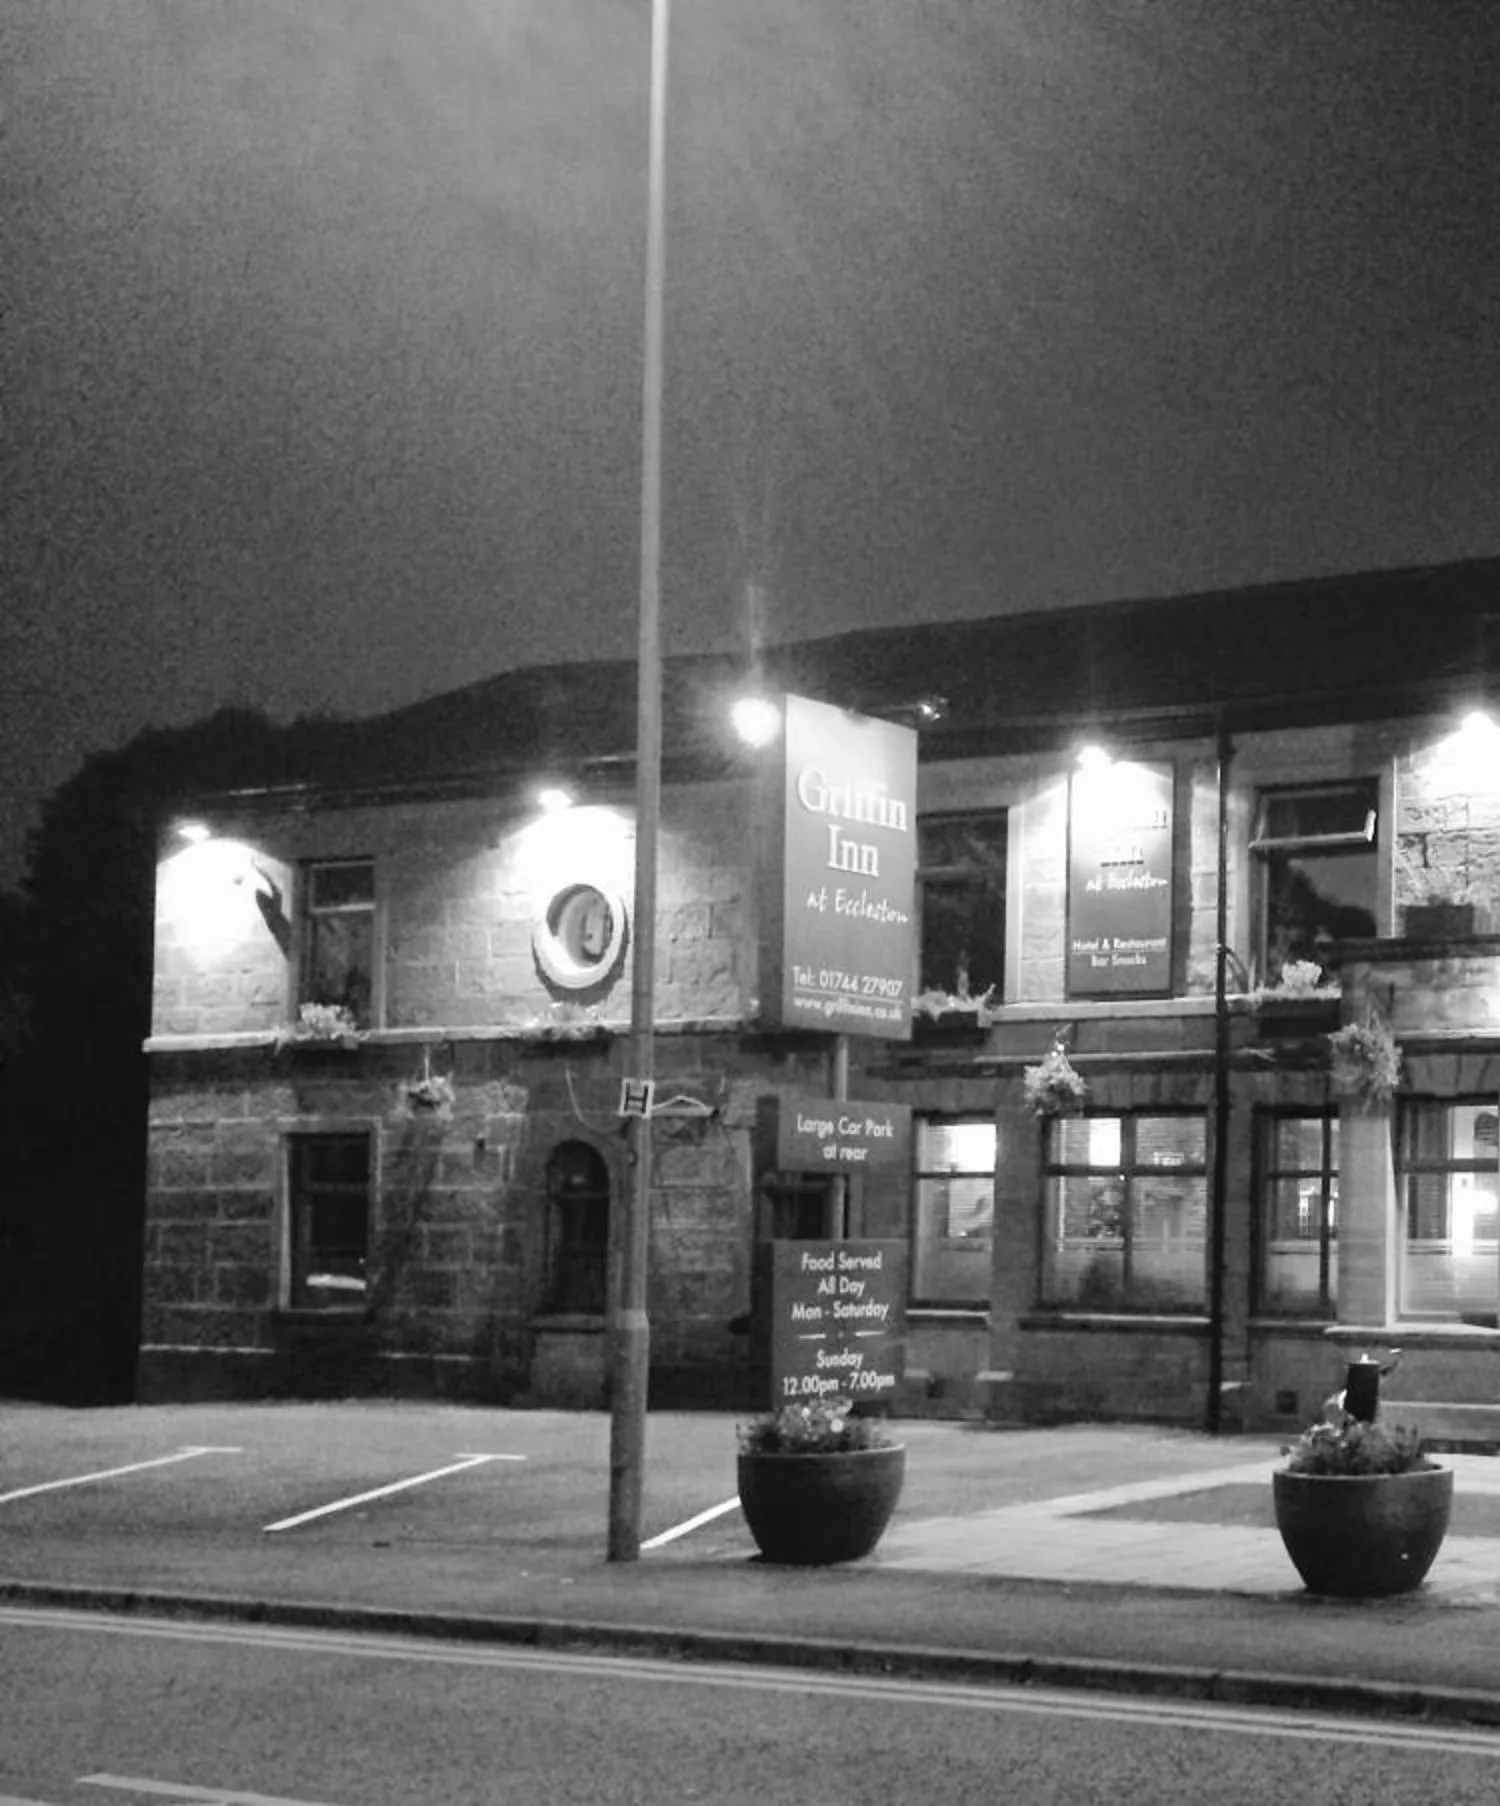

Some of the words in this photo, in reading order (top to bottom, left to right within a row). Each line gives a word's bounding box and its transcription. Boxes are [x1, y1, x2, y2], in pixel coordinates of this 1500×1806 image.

[798, 766, 908, 832] Griffin
[827, 824, 880, 877] Inn
[835, 887, 909, 923] Eccleston
[624, 1081, 649, 1113] H
[797, 1112, 834, 1139] Large
[838, 1115, 862, 1136] Car
[865, 1117, 894, 1138] Park
[822, 1142, 837, 1160] at
[840, 1147, 868, 1161] rear
[801, 1250, 835, 1272] Food
[838, 1250, 883, 1271] Served
[817, 1275, 837, 1295] All
[839, 1275, 866, 1298] Day
[833, 1297, 889, 1322] Saturday
[816, 1347, 864, 1370] Sunday
[783, 1374, 839, 1398] 12.00pm
[849, 1370, 896, 1393] 7.00pm
